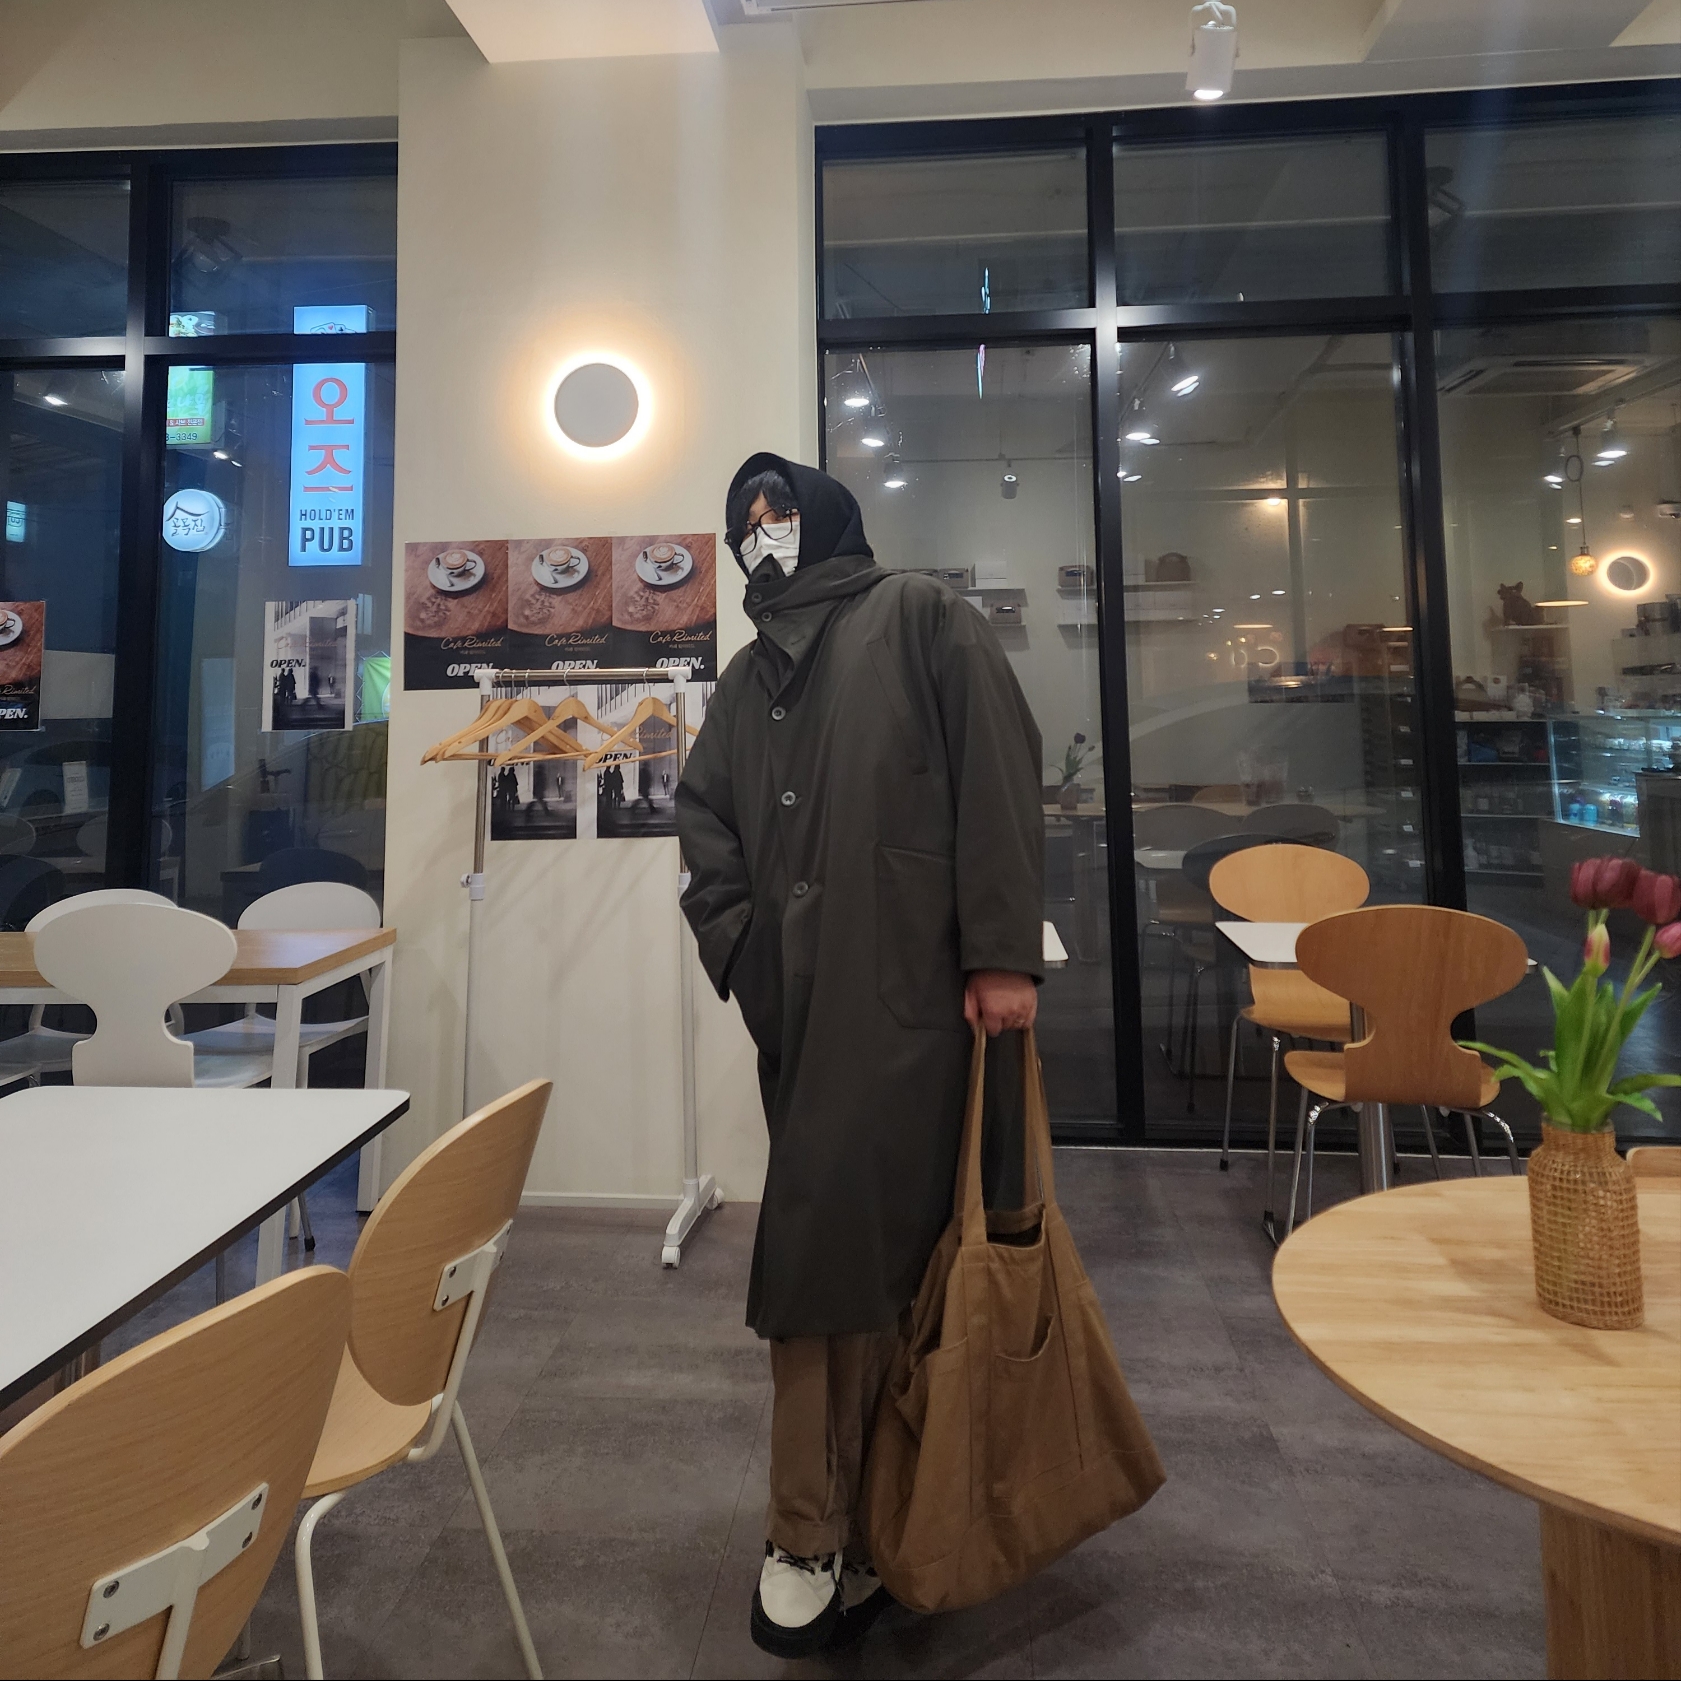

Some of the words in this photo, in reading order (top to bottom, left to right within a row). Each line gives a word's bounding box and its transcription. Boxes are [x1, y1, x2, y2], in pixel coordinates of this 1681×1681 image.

[303, 377, 355, 493] 오즈
[299, 508, 355, 522] HOLD'EM
[299, 526, 355, 553] PUB
[649, 630, 671, 643] Cafe
[270, 658, 307, 669] OPEN.
[655, 656, 705, 670] OPEN.
